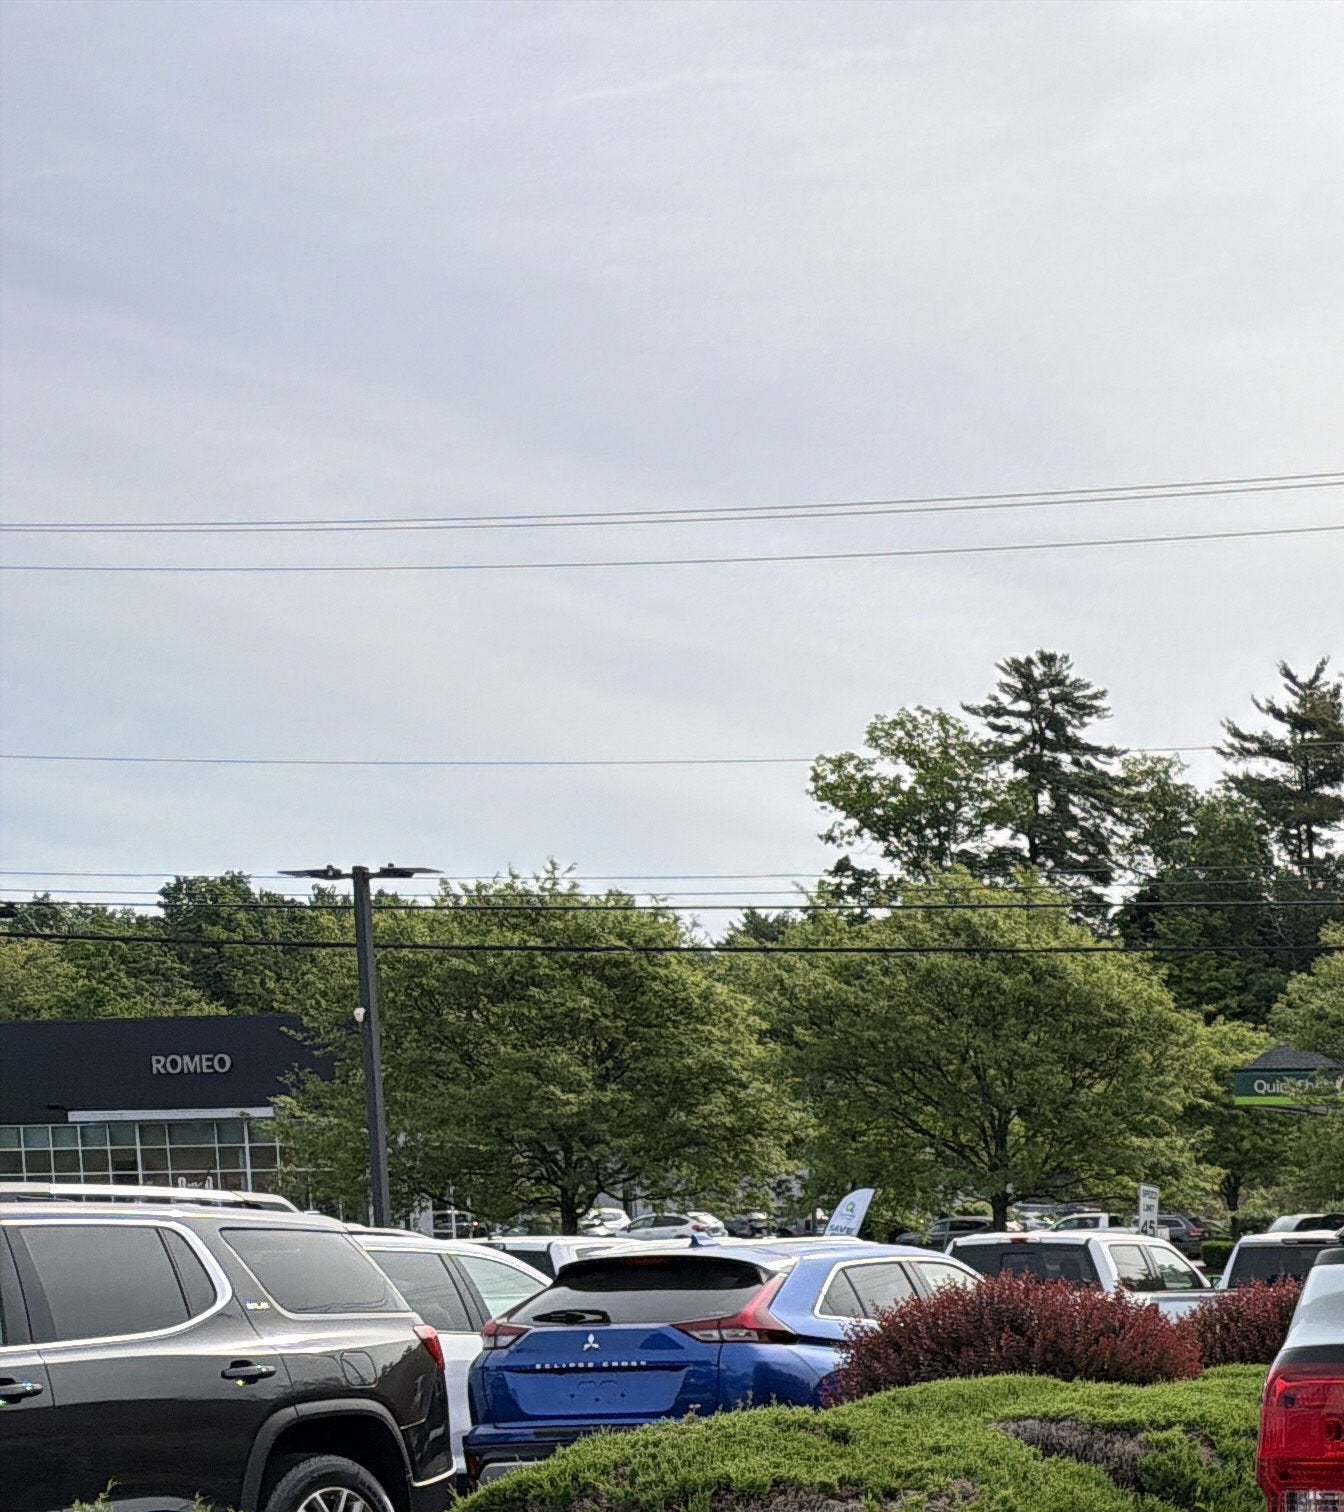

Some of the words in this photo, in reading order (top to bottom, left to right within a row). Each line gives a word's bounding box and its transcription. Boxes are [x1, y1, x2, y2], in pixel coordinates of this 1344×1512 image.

[151, 1053, 232, 1075] ROMEO
[1140, 1219, 1156, 1237] 45
[535, 1362, 594, 1370] ECLIPSE
[602, 1360, 647, 1368] CROSS
